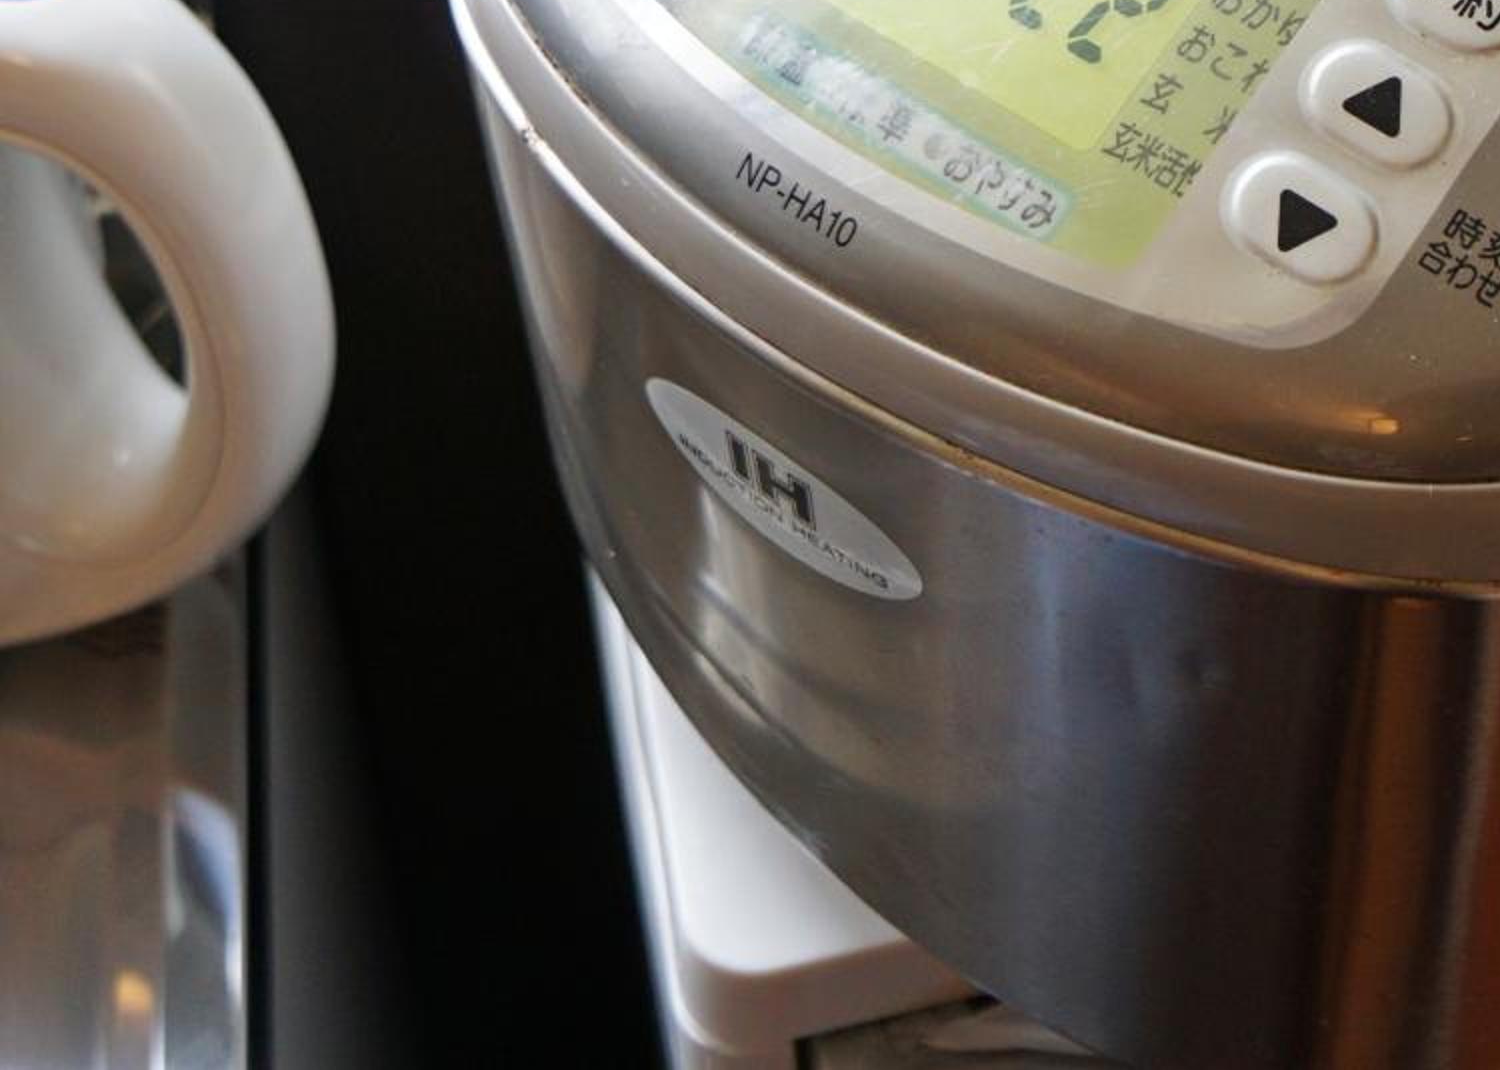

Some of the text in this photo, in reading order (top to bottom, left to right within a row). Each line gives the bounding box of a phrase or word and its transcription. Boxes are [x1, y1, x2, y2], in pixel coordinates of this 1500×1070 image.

[735, 152, 858, 248] NP-HA10
[724, 429, 817, 532] IH
[792, 521, 889, 590] HEATING
